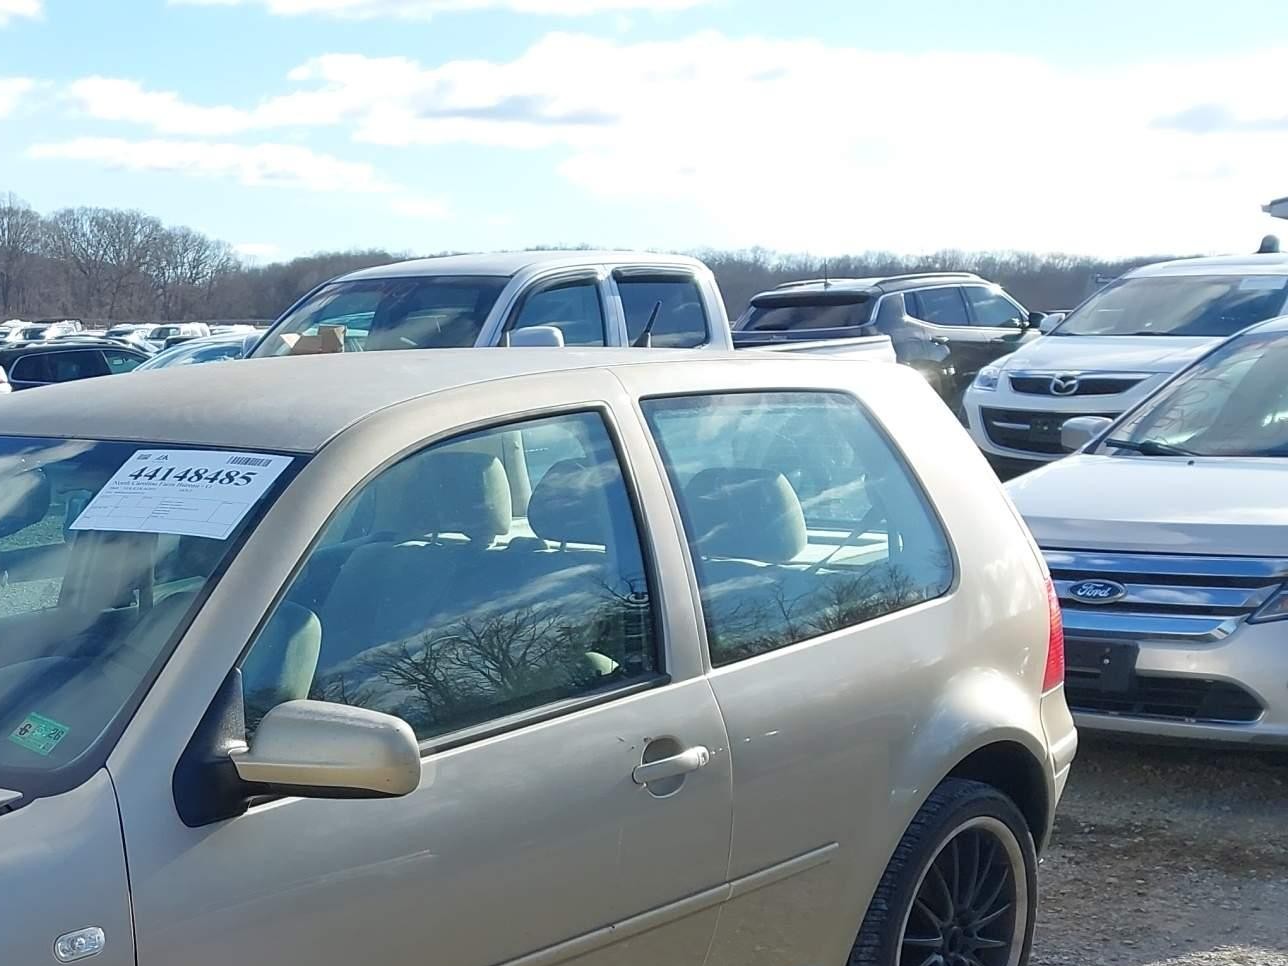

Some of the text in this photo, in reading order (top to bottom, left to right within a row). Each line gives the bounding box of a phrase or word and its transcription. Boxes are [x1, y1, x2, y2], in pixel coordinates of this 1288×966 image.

[127, 466, 258, 486] 44148485
[1077, 583, 1112, 597] Ford
[47, 727, 65, 741] 26
